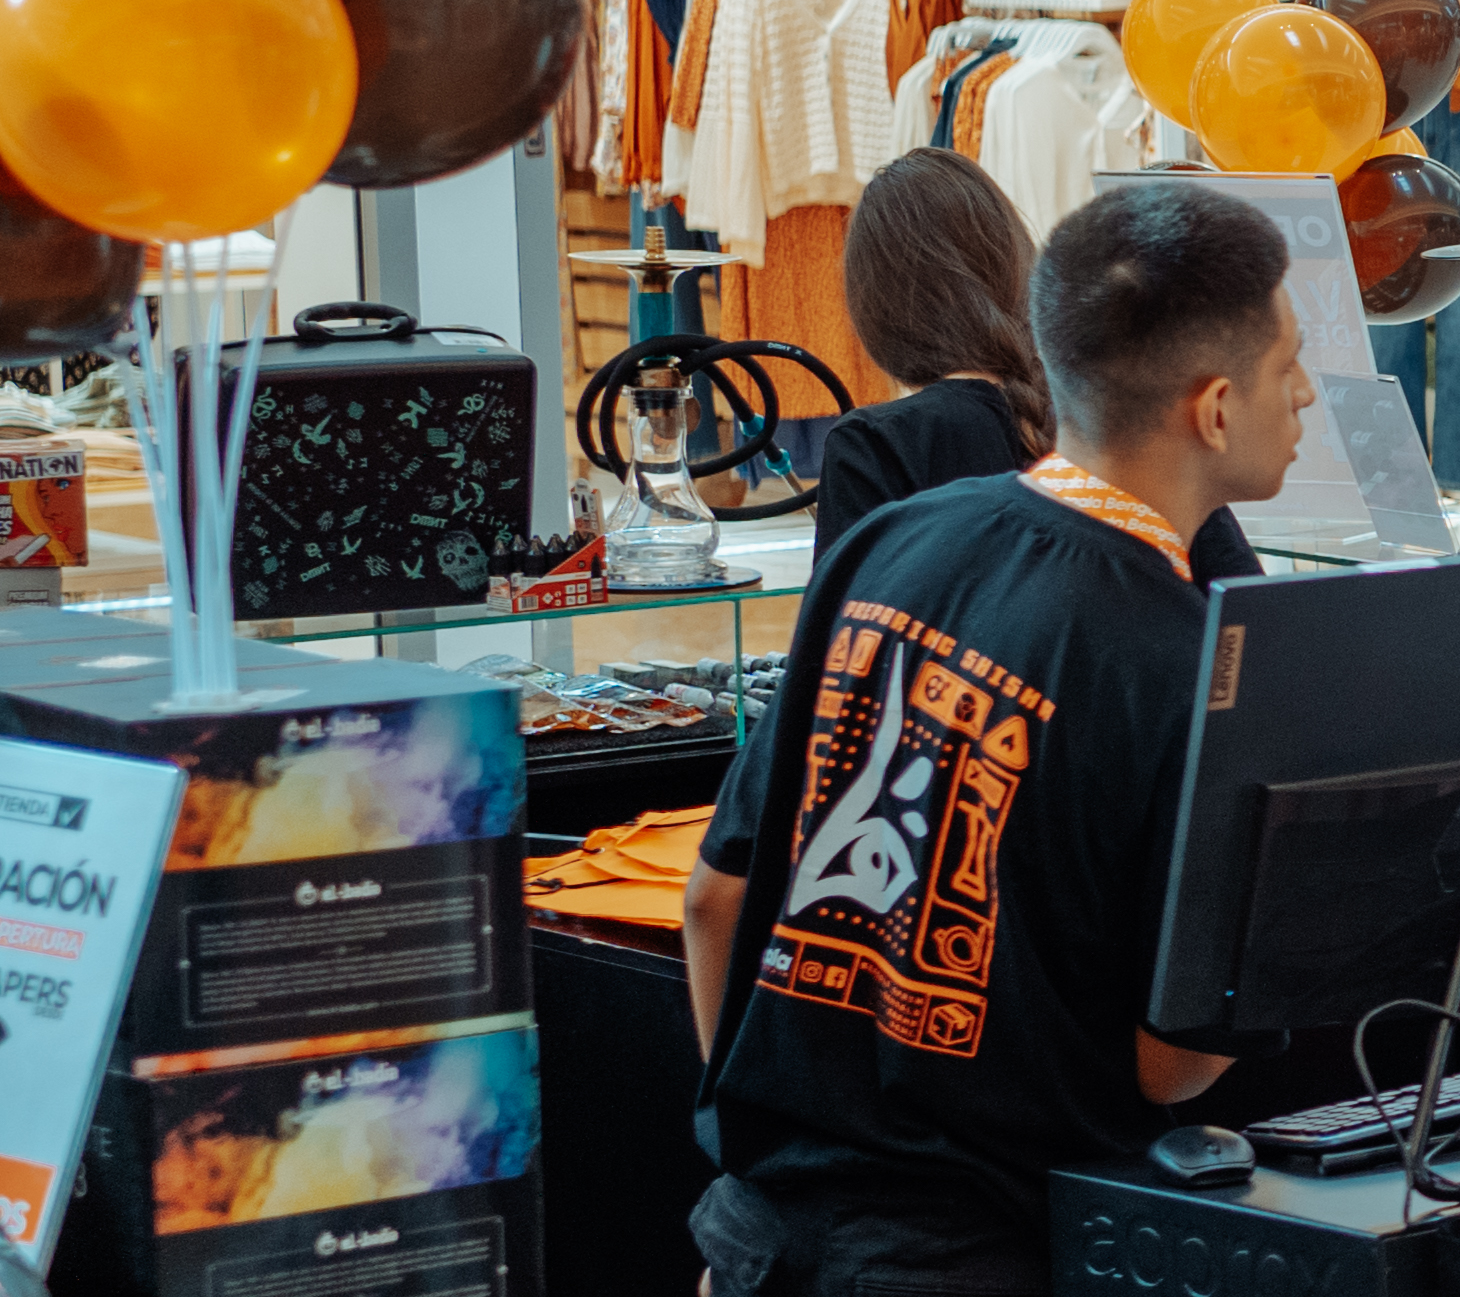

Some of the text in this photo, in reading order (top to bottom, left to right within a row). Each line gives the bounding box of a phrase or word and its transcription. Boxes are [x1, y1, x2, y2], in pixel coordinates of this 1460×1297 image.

[1211, 633, 1238, 702] Lenovo
[0, 858, 118, 919] ACIÓN
[0, 969, 72, 1009] PERS
